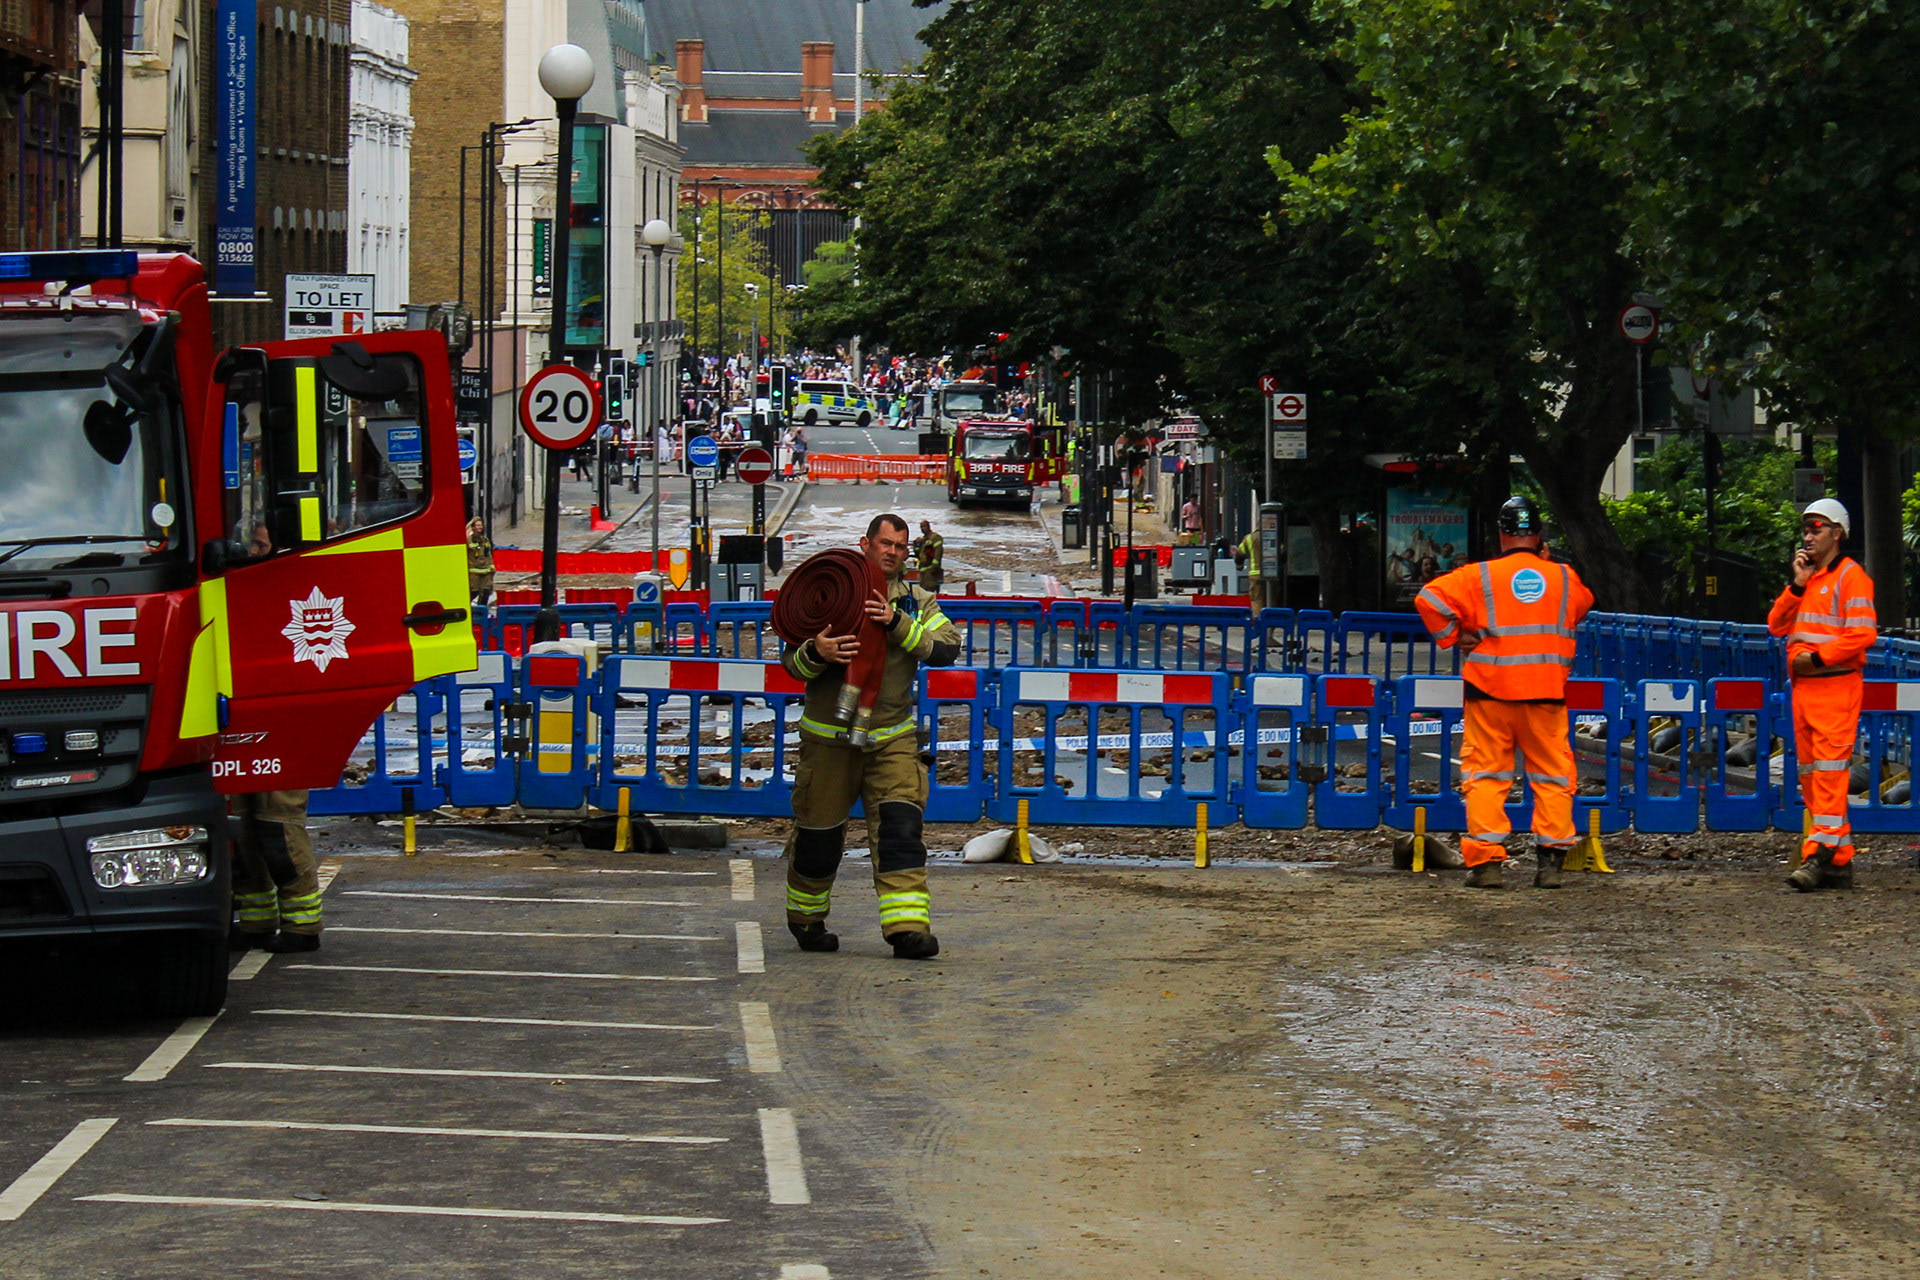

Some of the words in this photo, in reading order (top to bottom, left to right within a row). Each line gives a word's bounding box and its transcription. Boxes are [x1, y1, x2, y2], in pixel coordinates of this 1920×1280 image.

[226, 11, 236, 40] Offices
[236, 35, 248, 60] Space
[227, 42, 236, 77] Serviced
[236, 63, 246, 89] Office
[236, 90, 246, 117] Virtual
[228, 88, 236, 141] environment
[236, 127, 246, 154] Rooms
[226, 143, 237, 178] working
[236, 155, 247, 189] Meeting
[228, 180, 238, 203] great
[227, 205, 236, 213] A
[218, 242, 253, 253] 0800
[218, 254, 254, 262] 515622
[295, 291, 322, 306] TO
[328, 292, 363, 307] LET
[461, 374, 480, 386] Big
[1264, 377, 1274, 391] K
[460, 387, 489, 399] Chil
[535, 389, 589, 424] 20
[1176, 425, 1199, 433] DAYS
[695, 469, 713, 477] Only
[1001, 464, 1026, 474] FIRE
[1389, 515, 1466, 525] TROUBLEMAKERS
[1264, 730, 1276, 741] DO
[1278, 729, 1291, 741] NO
[1412, 723, 1424, 734] DO
[1425, 722, 1442, 733] NOT
[1065, 737, 1088, 748] POLIC
[1098, 736, 1114, 747] INE
[1145, 734, 1173, 746] CROSS
[211, 760, 247, 777] DPL
[252, 758, 282, 775] 326
[15, 775, 72, 787] Emergency
